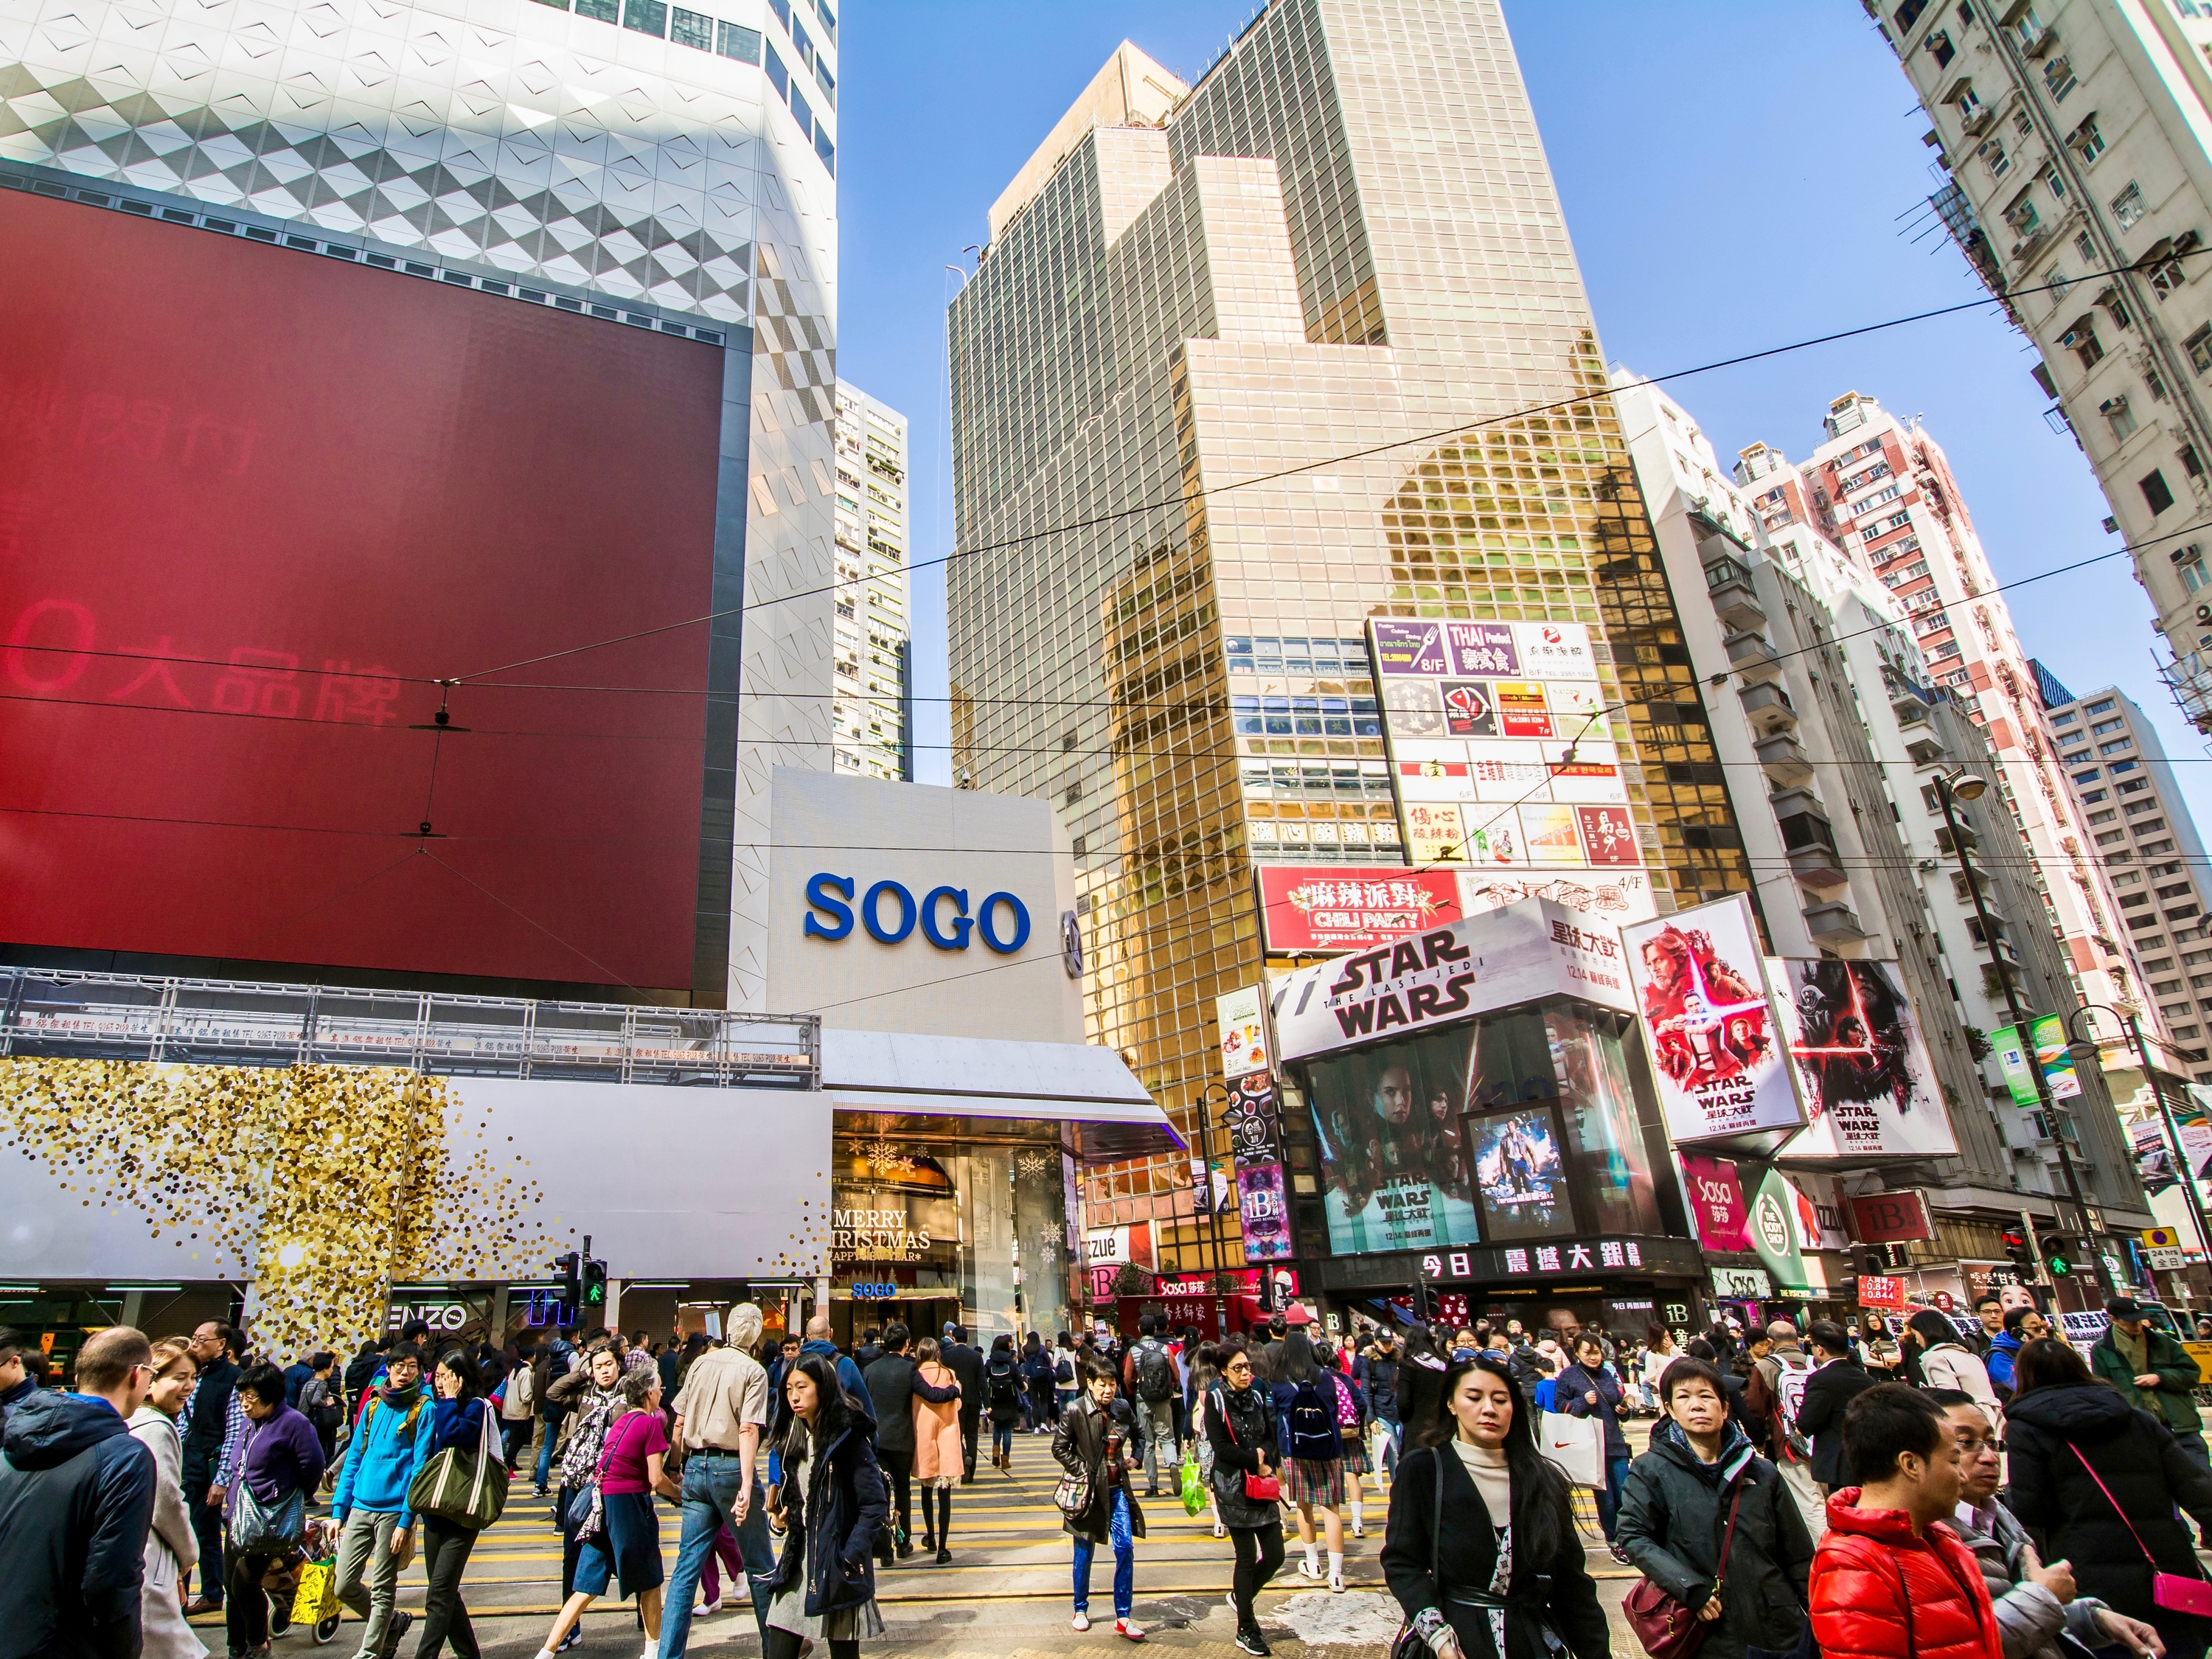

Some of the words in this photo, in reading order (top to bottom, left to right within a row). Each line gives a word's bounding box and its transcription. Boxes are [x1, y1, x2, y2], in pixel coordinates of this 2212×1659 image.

[1449, 626, 1486, 647] THAI
[1421, 658, 1444, 672] 8/F
[1461, 647, 1510, 672] 泰式食
[1538, 726, 1551, 734] 7/F
[1459, 790, 1473, 799] 6/F
[1535, 791, 1548, 799] 6/F
[1610, 793, 1623, 801] 6/F
[1411, 807, 1455, 826] 傷心
[1413, 827, 1460, 840] 酸辣粉
[1486, 827, 1502, 836] 5/F
[1618, 875, 1643, 892] 4/F
[1311, 882, 1416, 908] 麻辣派對
[805, 872, 1032, 954] SOGO
[1314, 912, 1360, 928] CHILI
[1364, 913, 1419, 928] PARTY
[1550, 919, 1619, 960] 星球大戰
[1330, 930, 1471, 996] STAR
[1566, 964, 1588, 981] 12.14
[1324, 993, 1354, 1009] THE
[1371, 975, 1416, 995] LAST
[1436, 957, 1484, 978] JEDI
[1334, 971, 1476, 1039] WARS
[2035, 1024, 2059, 1037] HONG
[2037, 1031, 2062, 1043] KONG
[1227, 1059, 1239, 1069] 3/F
[1694, 1076, 1753, 1094] STAR
[1697, 1090, 1756, 1110] WARS
[1705, 1105, 1756, 1120] 星球大戰
[1835, 1107, 1878, 1117] STAR
[1837, 1121, 1880, 1131] WARS
[1374, 1172, 1430, 1191] STAR
[1246, 1192, 1272, 1218] iB
[1376, 1190, 1432, 1210] WARS
[833, 1209, 908, 1228] MERRY
[1711, 1205, 1730, 1223] 莎莎
[1764, 1211, 1777, 1221] THE
[1867, 1202, 1906, 1231] iB
[1764, 1222, 1784, 1234] BODY
[1767, 1234, 1784, 1245] SHOP
[832, 1251, 860, 1262] APPY
[1422, 1253, 1472, 1278] 今日
[1505, 1242, 1643, 1273] 震撼大銀幕
[2157, 1258, 2180, 1267] 全日
[852, 1282, 897, 1298] SOGO
[1188, 1280, 1206, 1294] 莎莎
[1866, 1283, 1894, 1291] 0.847
[1867, 1291, 1894, 1300] 0.844
[448, 1313, 461, 1322] PARIS
[1326, 1313, 1340, 1330] iB
[1666, 1304, 1689, 1323] iB
